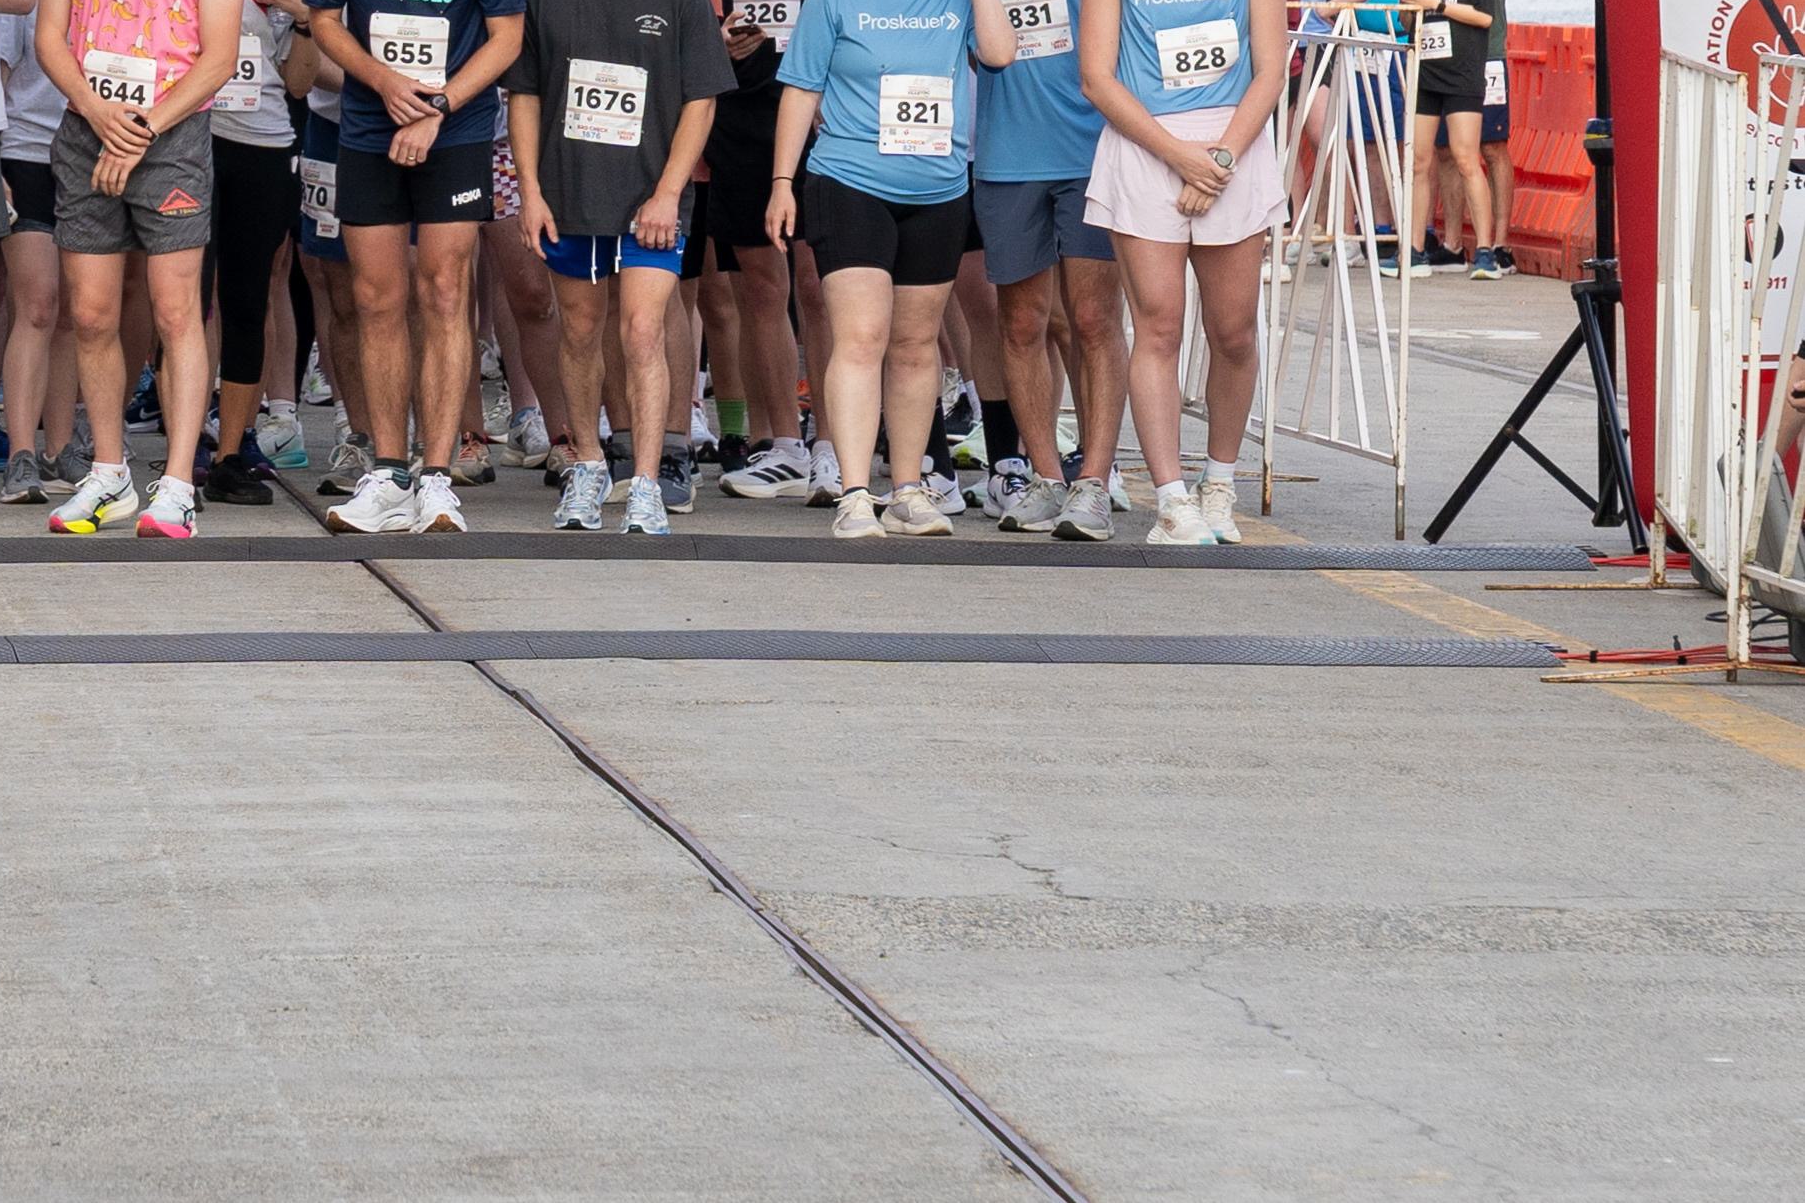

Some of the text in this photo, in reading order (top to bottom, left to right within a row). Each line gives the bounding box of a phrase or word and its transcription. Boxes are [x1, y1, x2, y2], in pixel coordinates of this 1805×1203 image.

[743, 3, 787, 24] 326
[858, 12, 945, 31] Proskauer
[1008, 3, 1052, 29] 831
[1707, 0, 1733, 64] ATION
[383, 41, 433, 65] 655
[1175, 47, 1226, 73] 828
[89, 76, 145, 105] 1644
[574, 86, 637, 114] 1676
[896, 101, 939, 124] 821
[452, 188, 482, 207] HOKA
